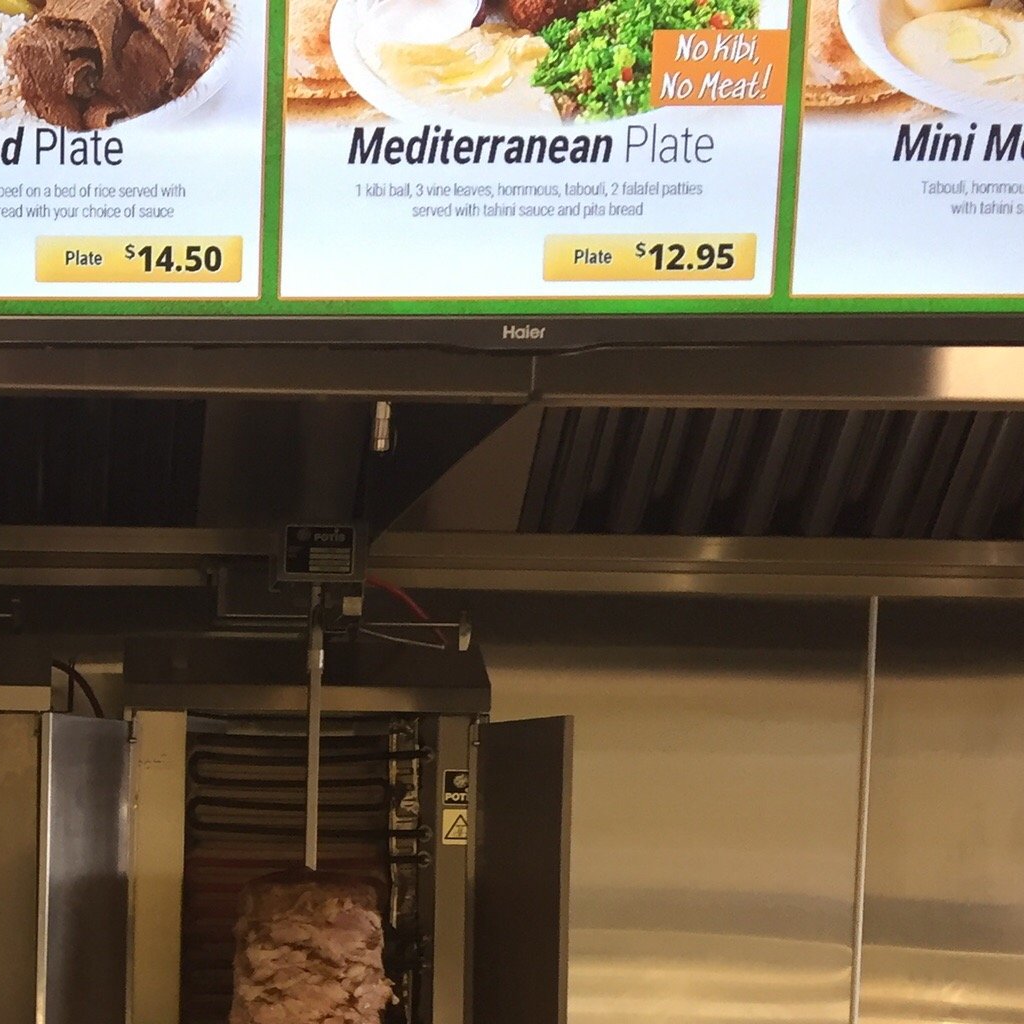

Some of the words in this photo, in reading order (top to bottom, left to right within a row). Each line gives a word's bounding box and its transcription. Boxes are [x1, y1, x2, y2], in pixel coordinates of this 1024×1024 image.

[674, 32, 709, 62] No
[713, 32, 760, 65] Kibi,
[659, 71, 694, 99] No
[697, 63, 774, 102] Meat!
[34, 127, 125, 166] Plate
[347, 124, 614, 165] Mediterranean
[624, 123, 716, 163] Plate
[892, 122, 978, 162] Mini
[983, 123, 1024, 162] M
[25, 186, 42, 198] on
[43, 187, 52, 198] a
[54, 184, 77, 198] bed
[78, 183, 92, 198] of
[94, 184, 117, 198] rice
[118, 184, 159, 198] served
[160, 184, 187, 198] with
[355, 183, 362, 197] 1
[365, 183, 386, 197] kibi
[389, 183, 413, 199] ball,
[415, 183, 424, 197] 3
[426, 184, 451, 197] vine
[453, 183, 496, 199] leaves,
[497, 183, 562, 198] hommous,
[564, 182, 609, 198] tabouli,
[610, 182, 619, 196] 2
[621, 181, 660, 196] falafel
[661, 181, 704, 199] patties
[921, 180, 969, 196] Tabouli,
[25, 204, 52, 218] with
[53, 206, 80, 221] your
[81, 204, 123, 218] choice
[123, 204, 137, 218] of
[138, 206, 176, 218] sauce
[412, 203, 452, 217] served
[454, 203, 481, 217] with
[483, 203, 517, 217] tahini
[518, 204, 555, 217] sauce
[556, 202, 581, 217] and
[582, 202, 607, 219] pita
[608, 202, 644, 217] bread
[951, 202, 977, 215] with
[979, 201, 1014, 215] tahini
[64, 251, 103, 266] Plate
[124, 244, 223, 273] $14.50
[573, 249, 613, 265] Plate
[635, 242, 735, 271] $12.95
[502, 324, 546, 340] Haier
